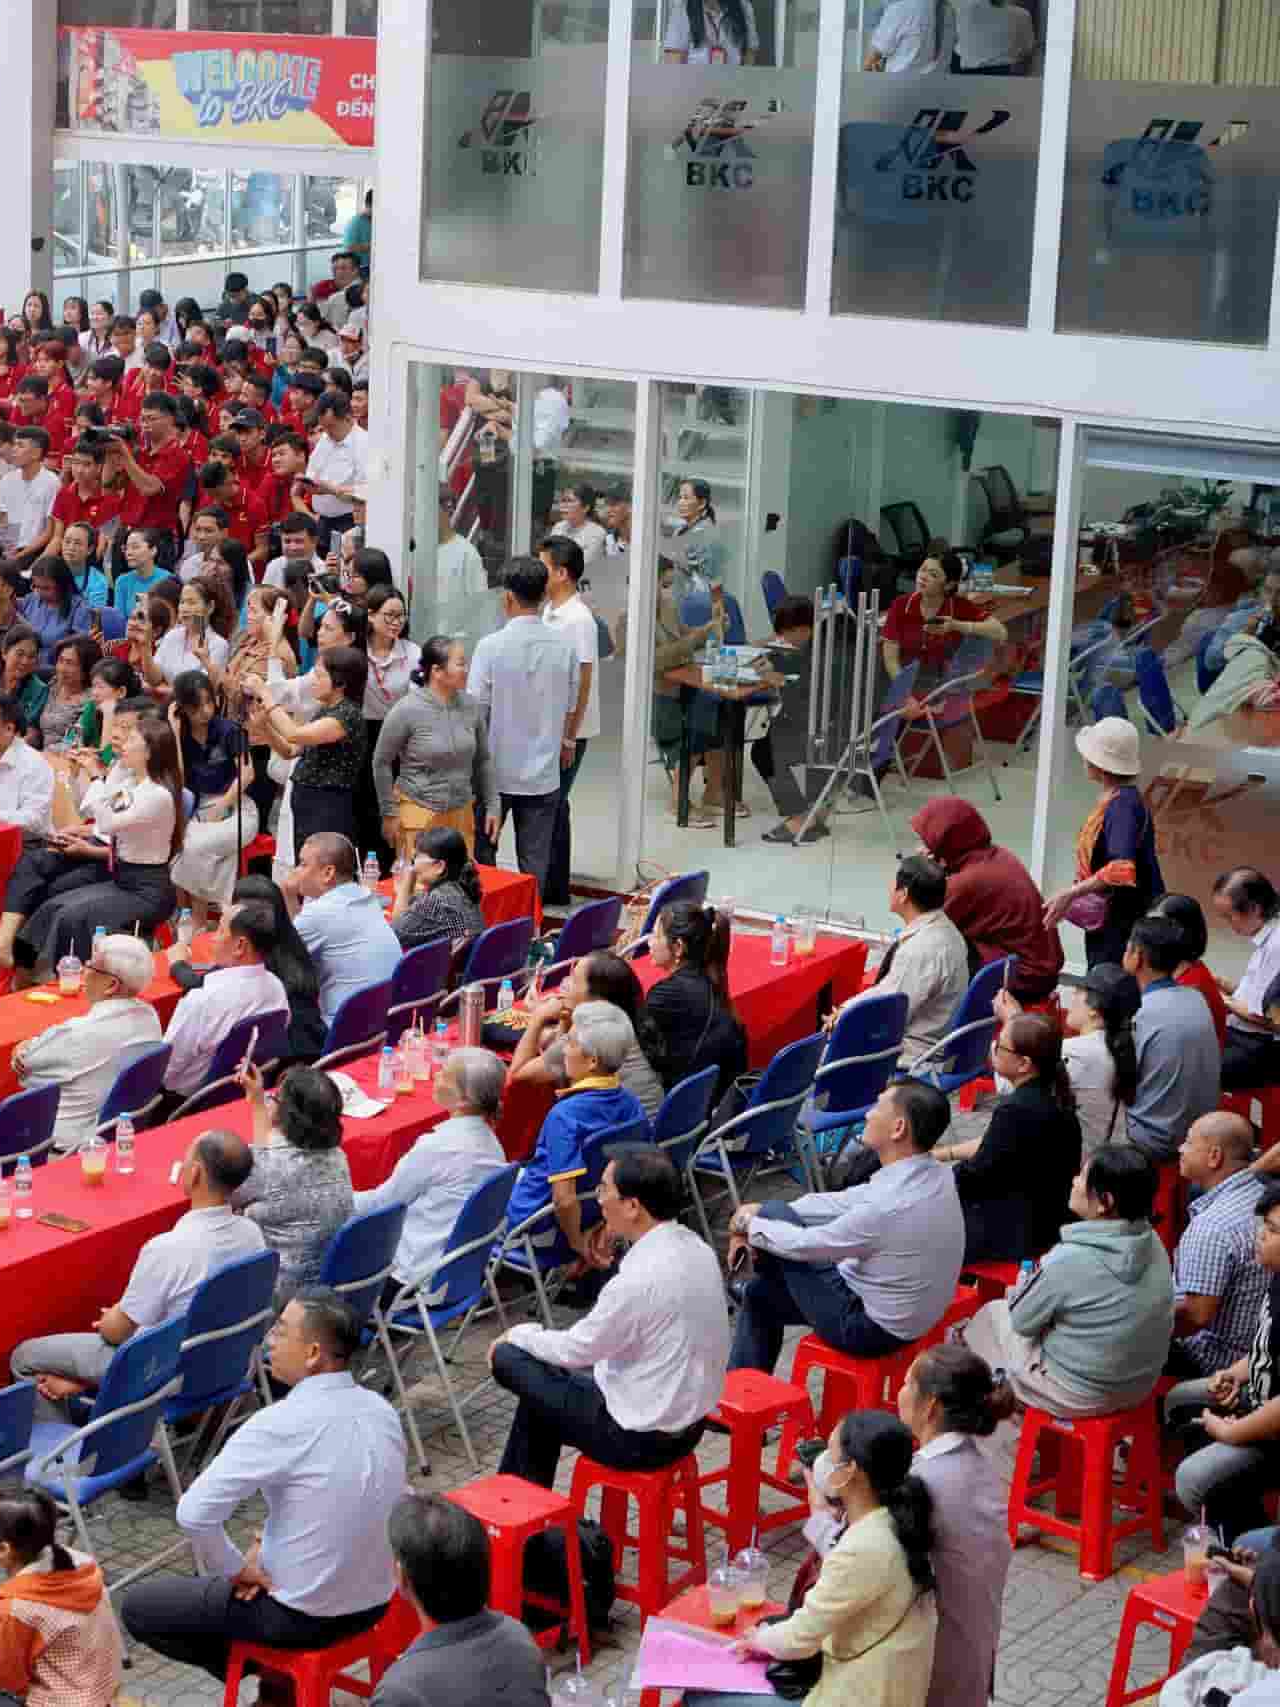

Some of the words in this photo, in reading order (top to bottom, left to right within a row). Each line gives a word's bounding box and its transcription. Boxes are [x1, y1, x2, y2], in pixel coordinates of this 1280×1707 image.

[232, 79, 291, 124] BKC
[686, 161, 753, 189] BKC
[903, 174, 976, 203] BKC
